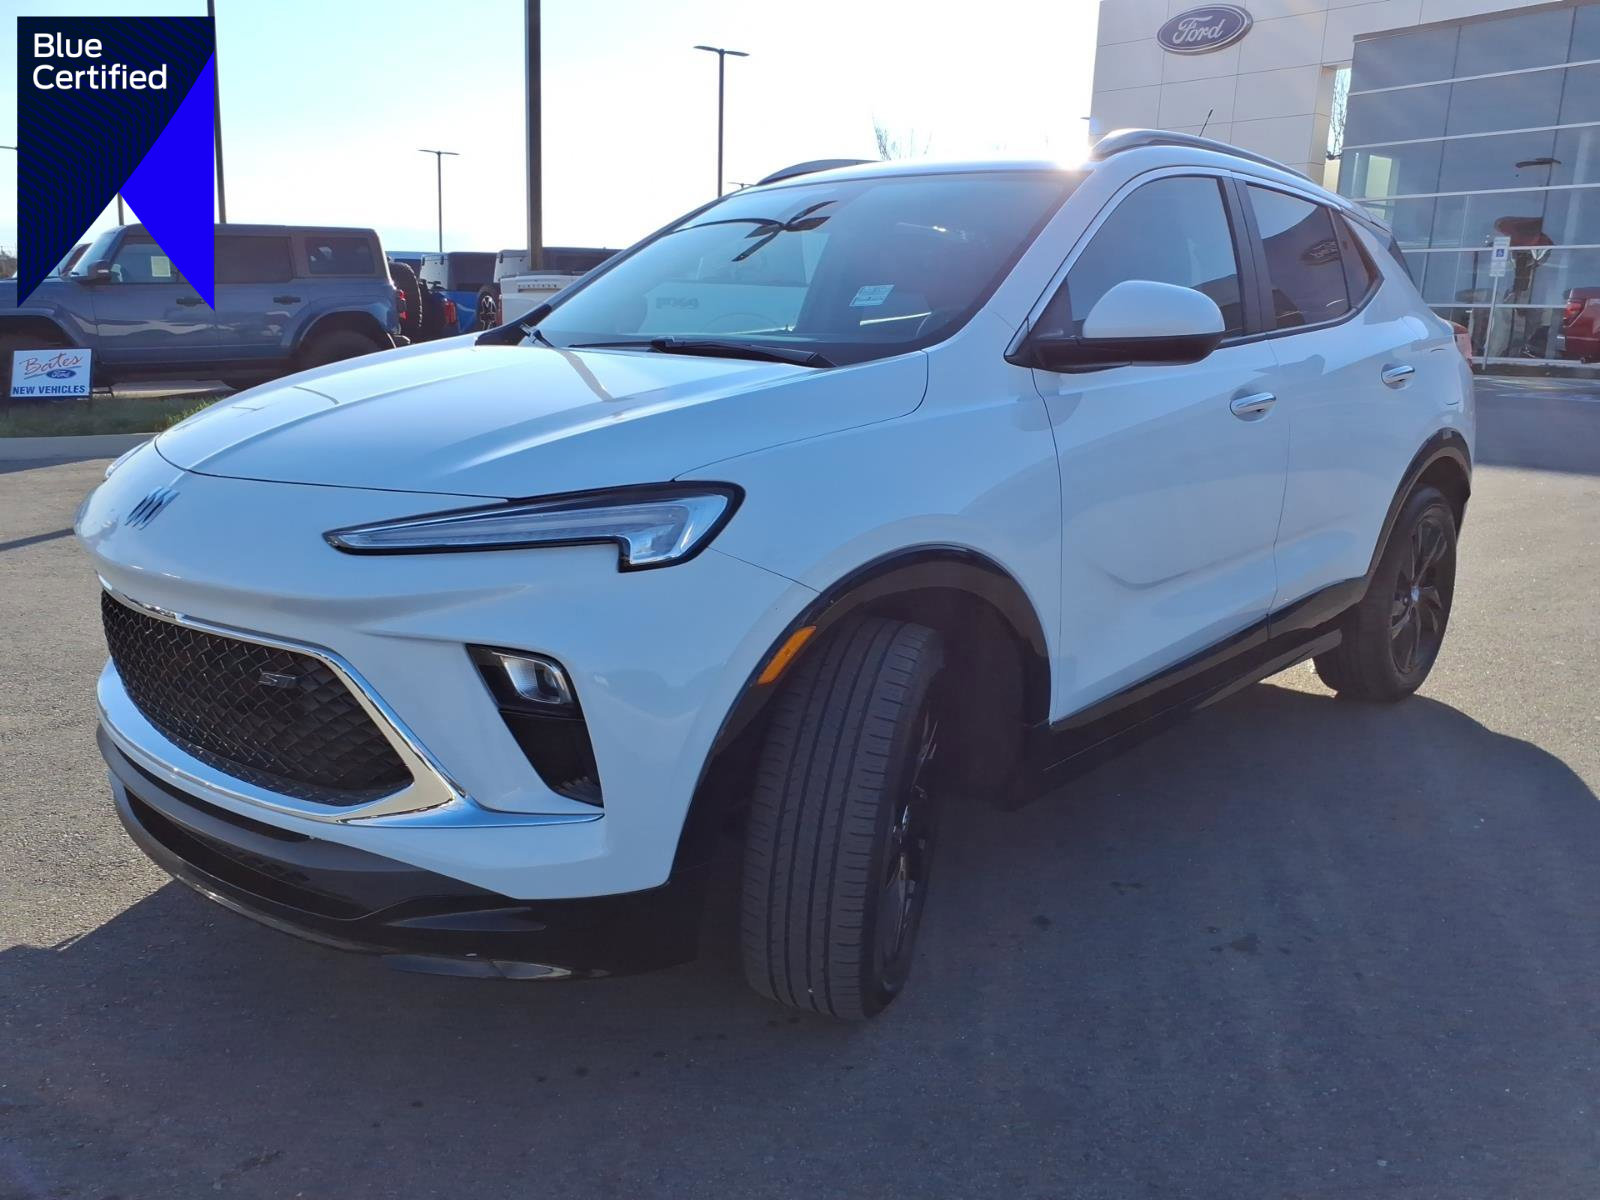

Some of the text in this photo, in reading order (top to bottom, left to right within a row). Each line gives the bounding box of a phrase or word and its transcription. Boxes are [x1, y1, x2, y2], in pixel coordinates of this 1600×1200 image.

[1172, 15, 1226, 44] Ford
[19, 352, 83, 376] Bates
[12, 385, 86, 395] NEW VEHICLES
